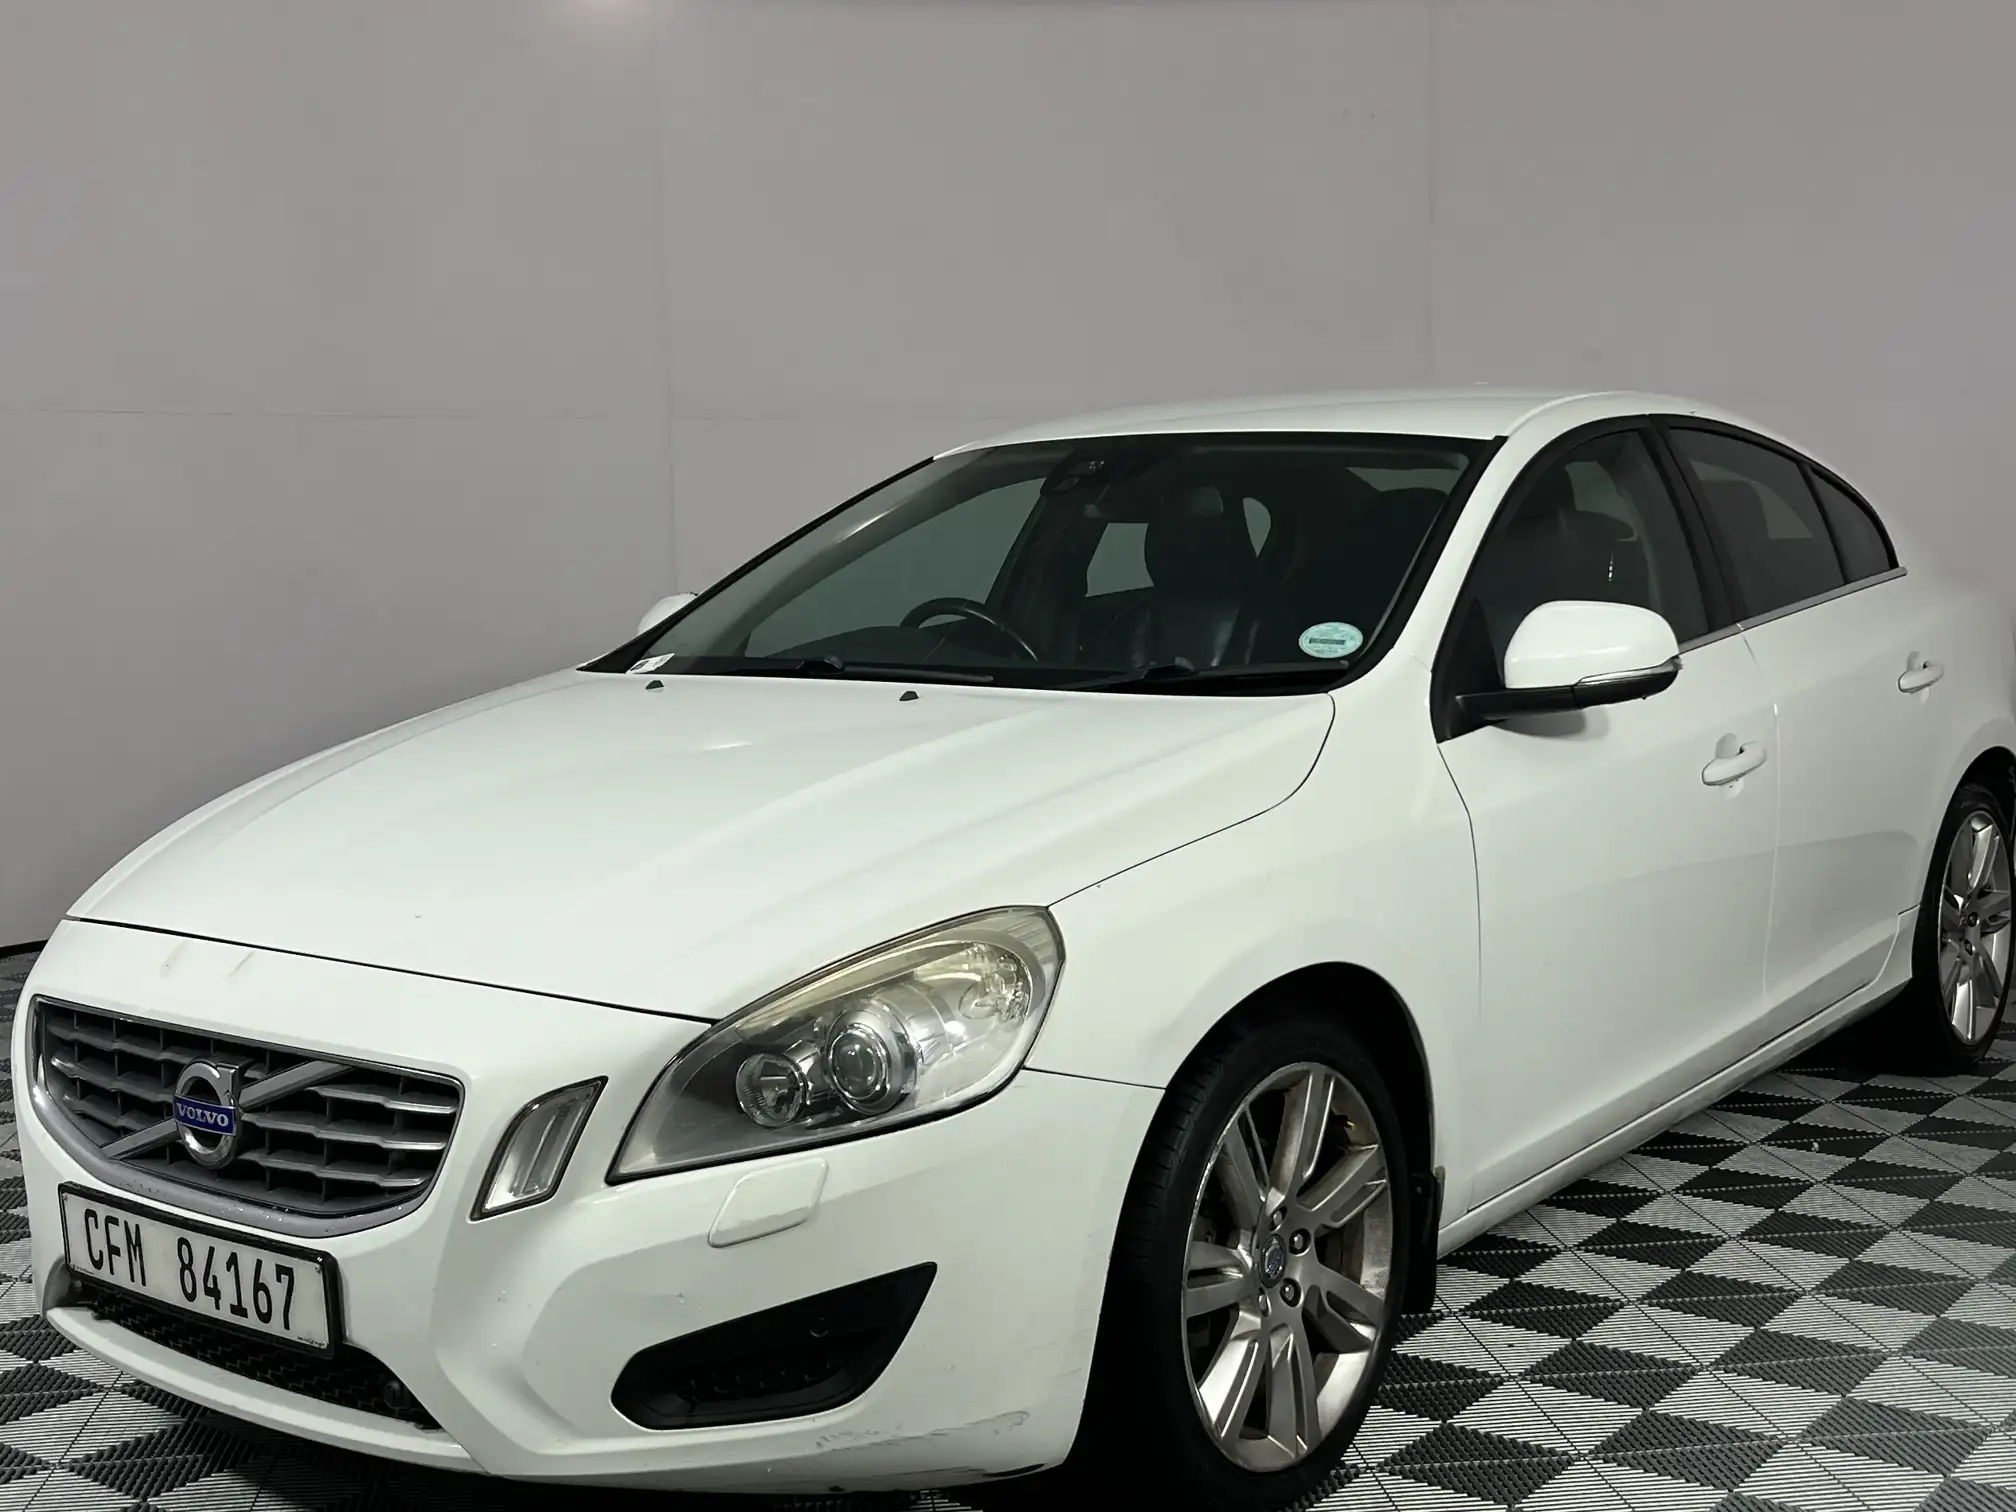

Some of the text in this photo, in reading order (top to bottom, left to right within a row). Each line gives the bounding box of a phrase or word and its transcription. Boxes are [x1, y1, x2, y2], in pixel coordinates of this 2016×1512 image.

[176, 1102, 229, 1127] VOLVO
[84, 1208, 294, 1331] CFM 84167
